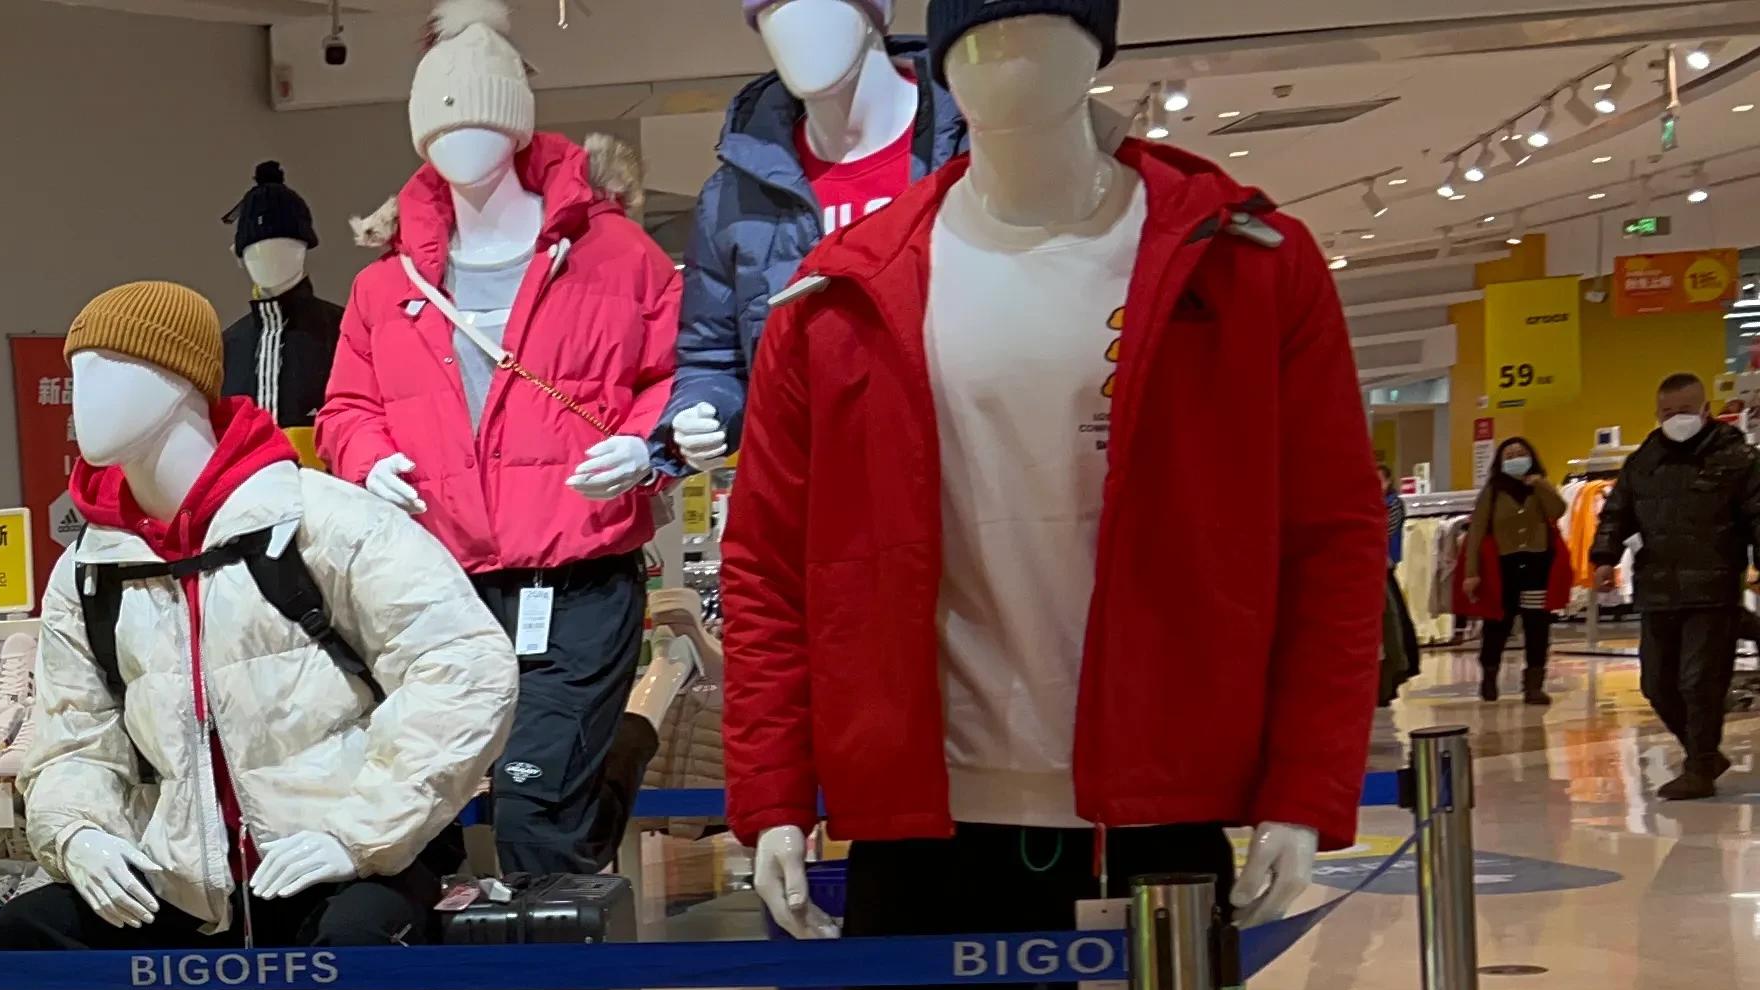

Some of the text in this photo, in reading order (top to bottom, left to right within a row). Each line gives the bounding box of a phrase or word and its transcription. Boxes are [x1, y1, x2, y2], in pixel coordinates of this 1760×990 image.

[1499, 363, 1534, 388] 59
[131, 951, 338, 986] BIGOFFS
[953, 937, 1129, 977] BIGO
